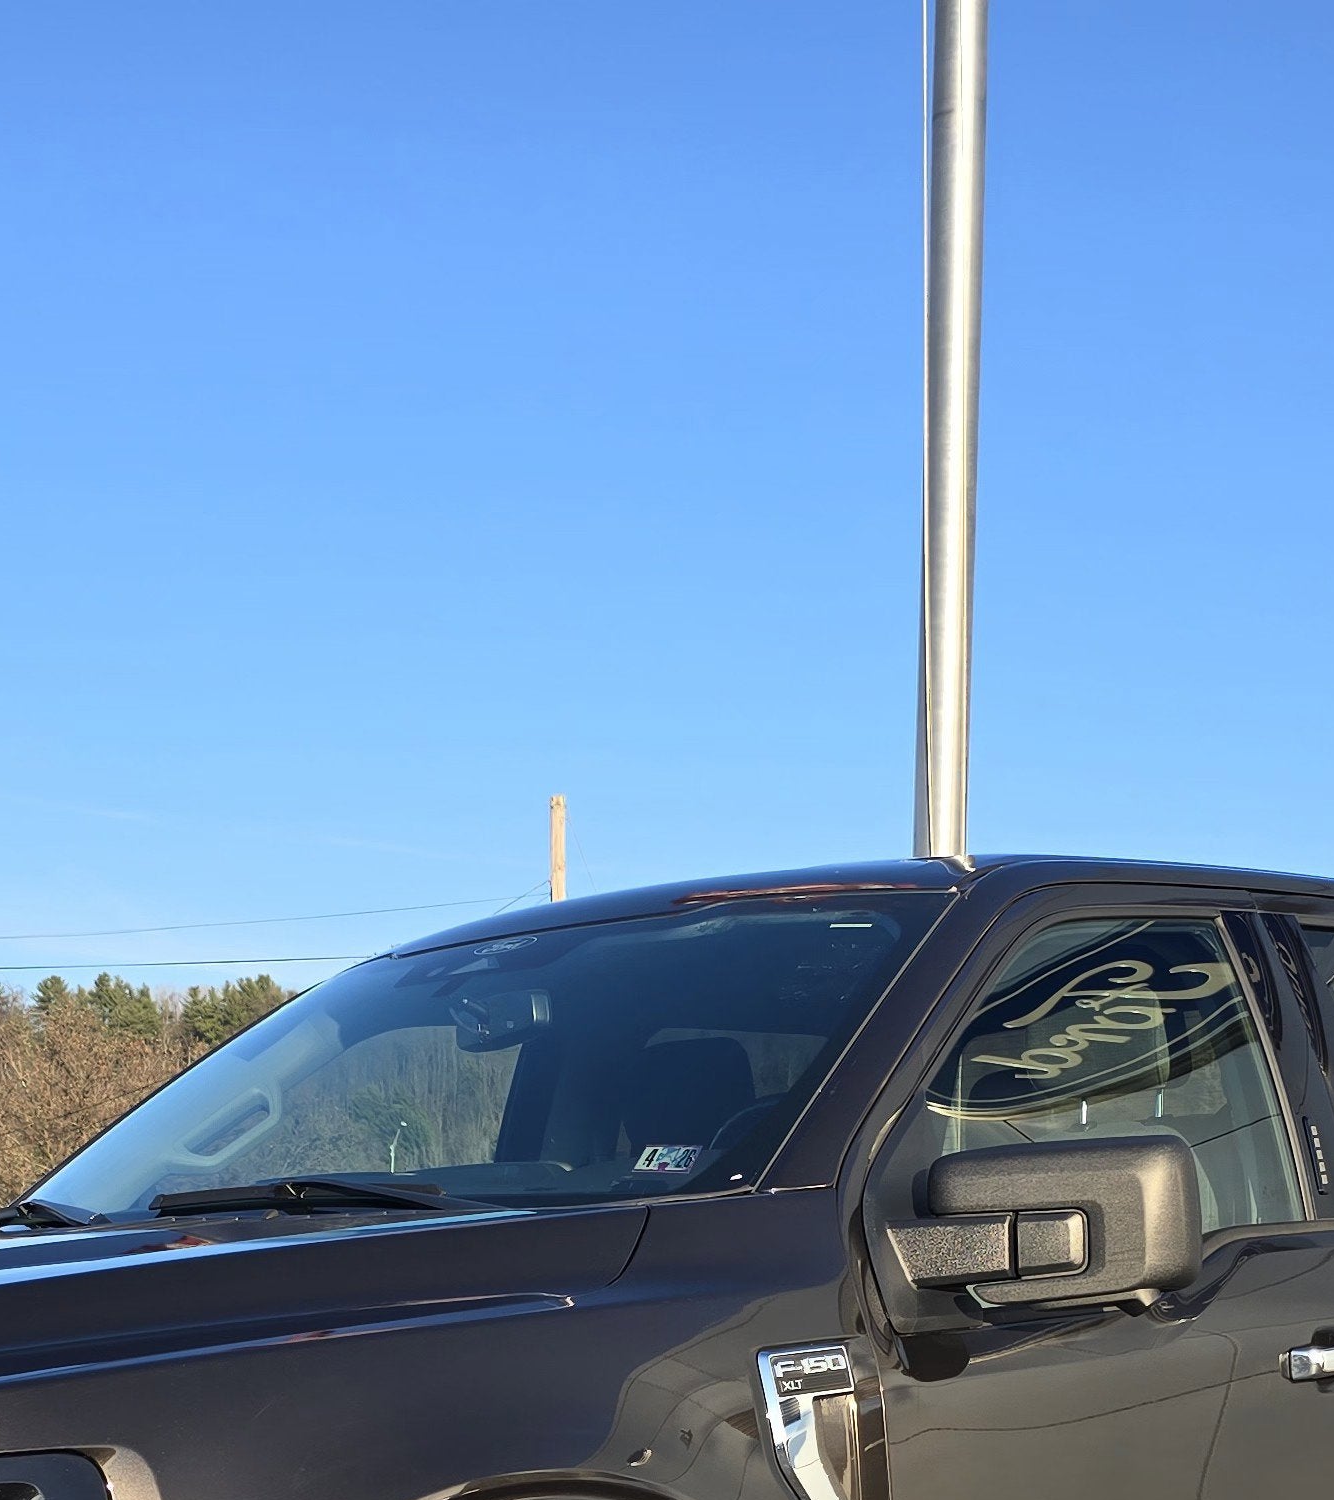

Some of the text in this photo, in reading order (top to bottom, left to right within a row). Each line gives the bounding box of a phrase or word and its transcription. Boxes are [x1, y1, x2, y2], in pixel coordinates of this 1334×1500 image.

[643, 1149, 697, 1168] 4 26
[774, 1354, 847, 1378] F-150
[781, 1378, 803, 1391] XLT
